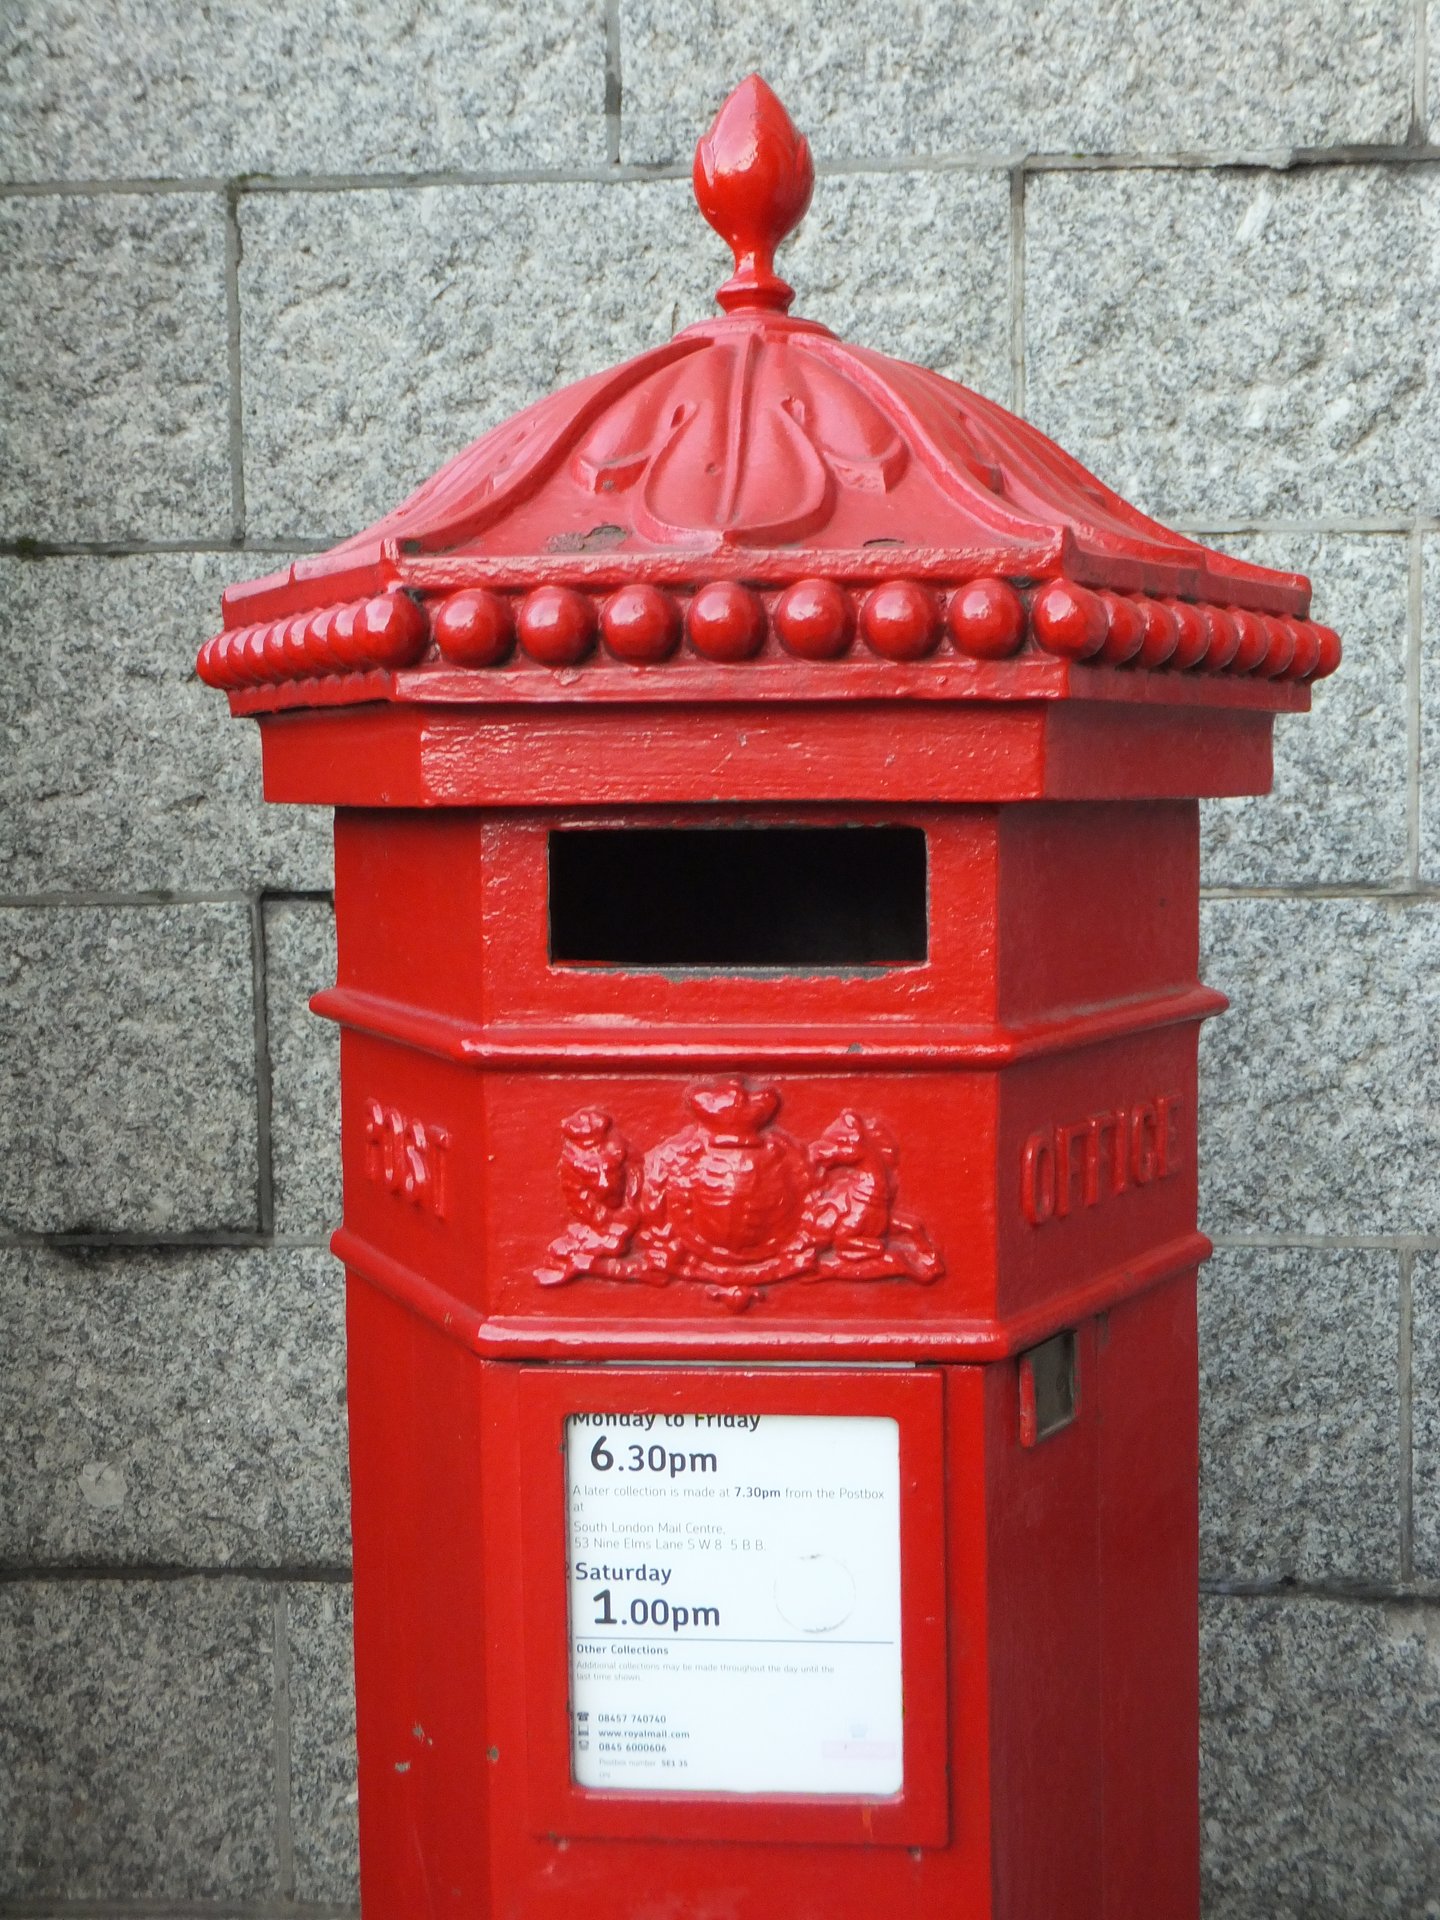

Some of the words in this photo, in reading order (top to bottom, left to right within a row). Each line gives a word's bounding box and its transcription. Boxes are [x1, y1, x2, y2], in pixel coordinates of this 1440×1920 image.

[1019, 1095, 1182, 1227] OFFICE
[572, 1414, 656, 1431] Monday
[664, 1414, 686, 1428] to
[694, 1414, 761, 1432] Friday
[590, 1435, 718, 1478] 6.30pm
[573, 1484, 581, 1496] A
[584, 1485, 609, 1497] later
[613, 1485, 667, 1498] collection
[670, 1486, 679, 1498] is
[683, 1486, 715, 1498] made
[719, 1487, 730, 1498] at
[734, 1486, 781, 1500] 7.30pm
[785, 1487, 813, 1499] from
[816, 1487, 836, 1499] the
[839, 1487, 885, 1500] Postbox
[573, 1502, 584, 1512] at
[573, 1520, 608, 1533] South
[611, 1521, 654, 1534] London
[658, 1522, 682, 1534] Mail
[685, 1522, 726, 1535] Centre,
[574, 1538, 589, 1549] 53
[593, 1538, 620, 1549] Nine
[624, 1538, 651, 1550] Elms
[655, 1538, 684, 1550] Lane
[575, 1561, 672, 1585] Saturday
[592, 1588, 720, 1631] 1.00pm
[576, 1643, 607, 1654] Other
[610, 1643, 669, 1655] Collections
[618, 1661, 660, 1671] collections
[662, 1663, 680, 1672] may
[695, 1663, 718, 1671] made
[720, 1663, 765, 1674] throughout
[768, 1663, 781, 1672] the
[783, 1664, 798, 1674] day
[800, 1664, 819, 1673] until
[821, 1664, 835, 1673] the
[598, 1713, 627, 1723] 08457
[632, 1714, 666, 1724] 740740
[598, 1729, 690, 1739] www.royalmail.com
[598, 1742, 622, 1752] 0845
[625, 1743, 667, 1753] 6000606
